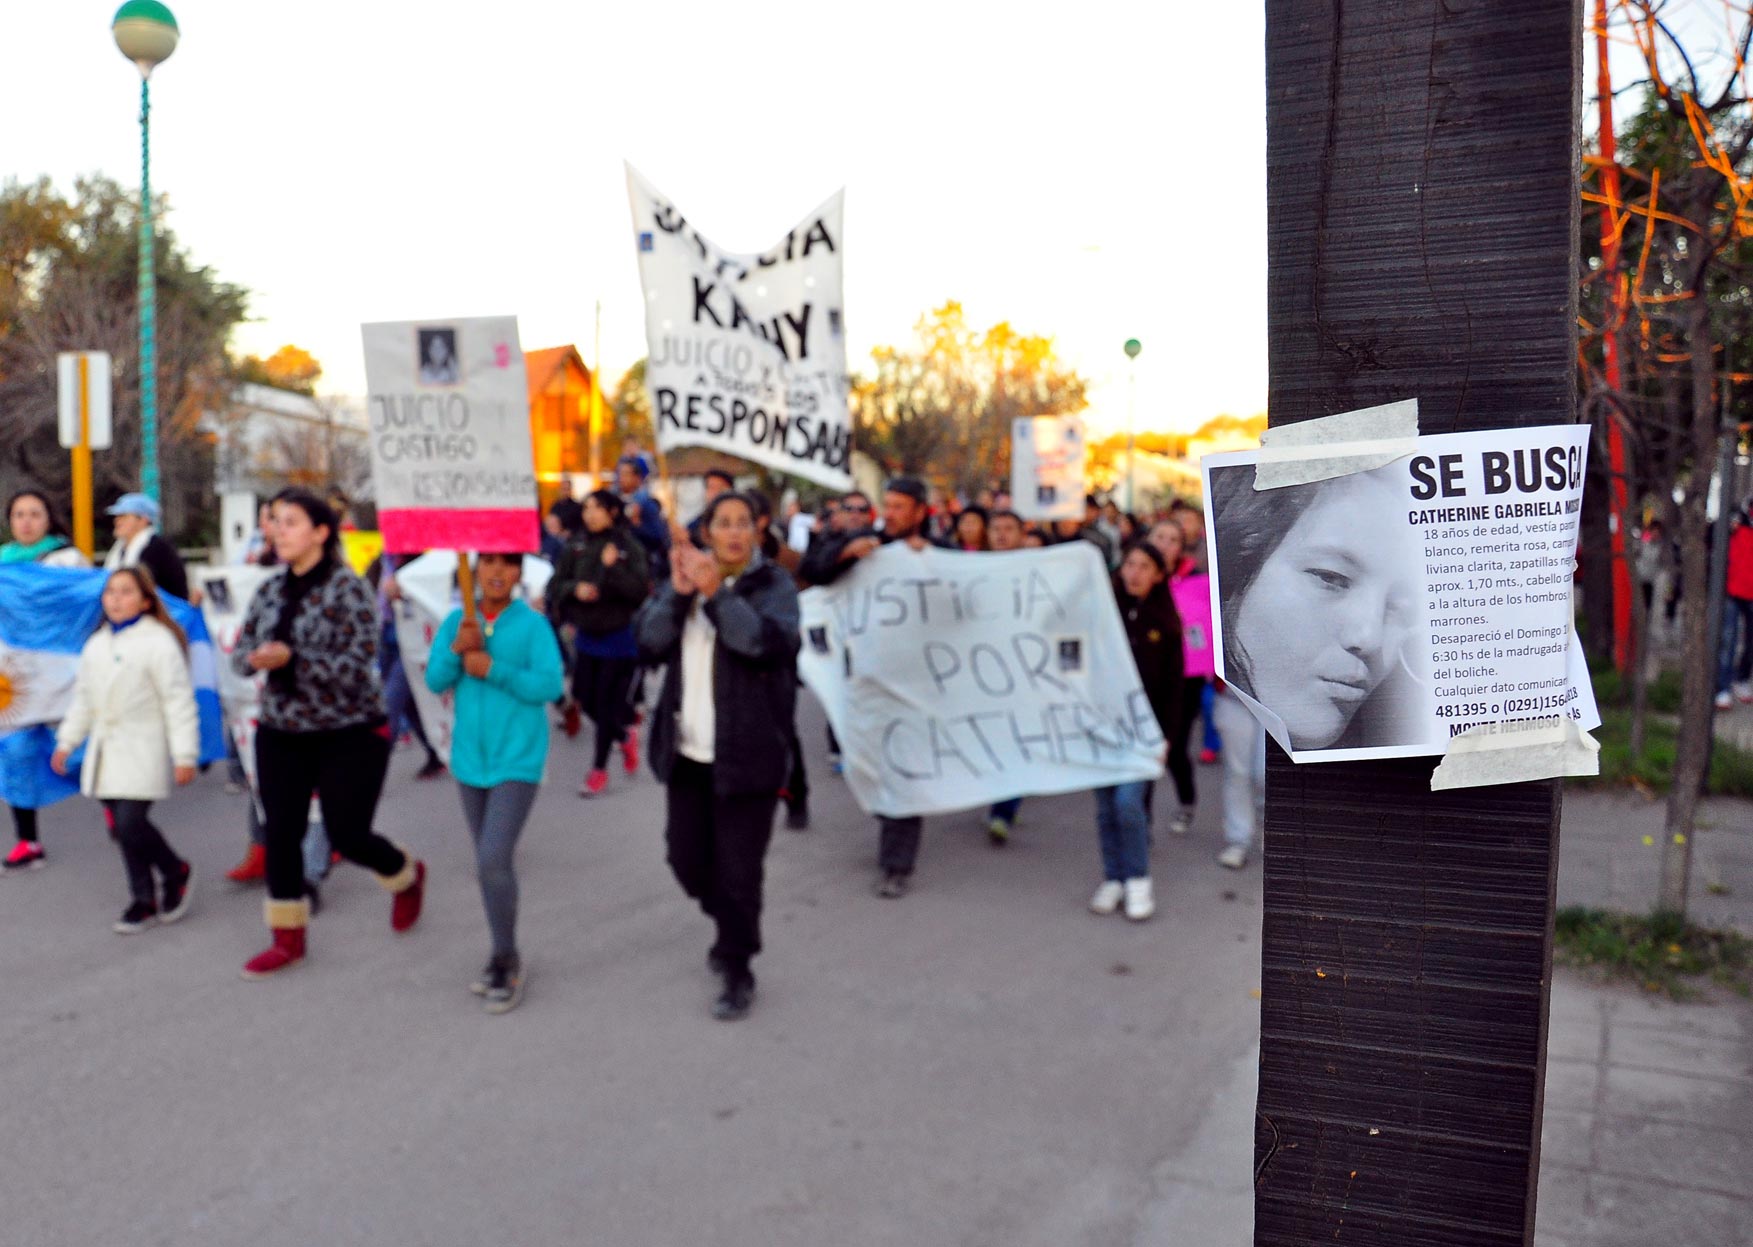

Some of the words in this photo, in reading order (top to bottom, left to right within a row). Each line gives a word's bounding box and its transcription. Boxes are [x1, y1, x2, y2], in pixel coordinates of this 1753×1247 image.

[1409, 454, 1466, 500] SE
[1482, 446, 1582, 494] BUSCA
[1408, 506, 1490, 525] CATHERINE
[1495, 501, 1562, 519] GABRIELA
[1424, 529, 1438, 540] 18
[1442, 526, 1470, 539] años
[1472, 526, 1487, 537] de
[1490, 523, 1522, 536] edad,
[1526, 520, 1556, 533] vestía
[1425, 546, 1467, 558] blanco,
[1470, 542, 1520, 554] remerita
[1523, 540, 1550, 552] rosa,
[1426, 563, 1464, 575] liviana
[1467, 560, 1507, 573] clarita,
[1509, 556, 1558, 572] zapatillas
[1428, 582, 1464, 594] aprox.
[1468, 578, 1492, 590] 1,70
[1496, 578, 1523, 588] mts.,
[1526, 574, 1562, 586] cabello
[1429, 602, 1436, 610] a
[1439, 598, 1449, 608] la
[1452, 598, 1486, 608] altura
[1490, 596, 1503, 606] de
[1506, 594, 1522, 604] los
[1430, 616, 1489, 627] marrones.
[1432, 629, 1500, 645] Desapareció
[1504, 629, 1514, 640] el
[1517, 626, 1562, 639] Domingo
[1432, 650, 1458, 662] 6:30
[1461, 649, 1474, 660] hs
[1477, 648, 1491, 659] de
[1494, 648, 1503, 658] la
[1506, 642, 1562, 657] madrugada
[923, 631, 1071, 697] POR
[1434, 668, 1451, 680] del
[1455, 666, 1498, 678] boliche.
[1435, 684, 1488, 698] Cualquier
[1491, 682, 1515, 693] dato
[1436, 703, 1487, 718] 481395
[1491, 704, 1499, 713] o
